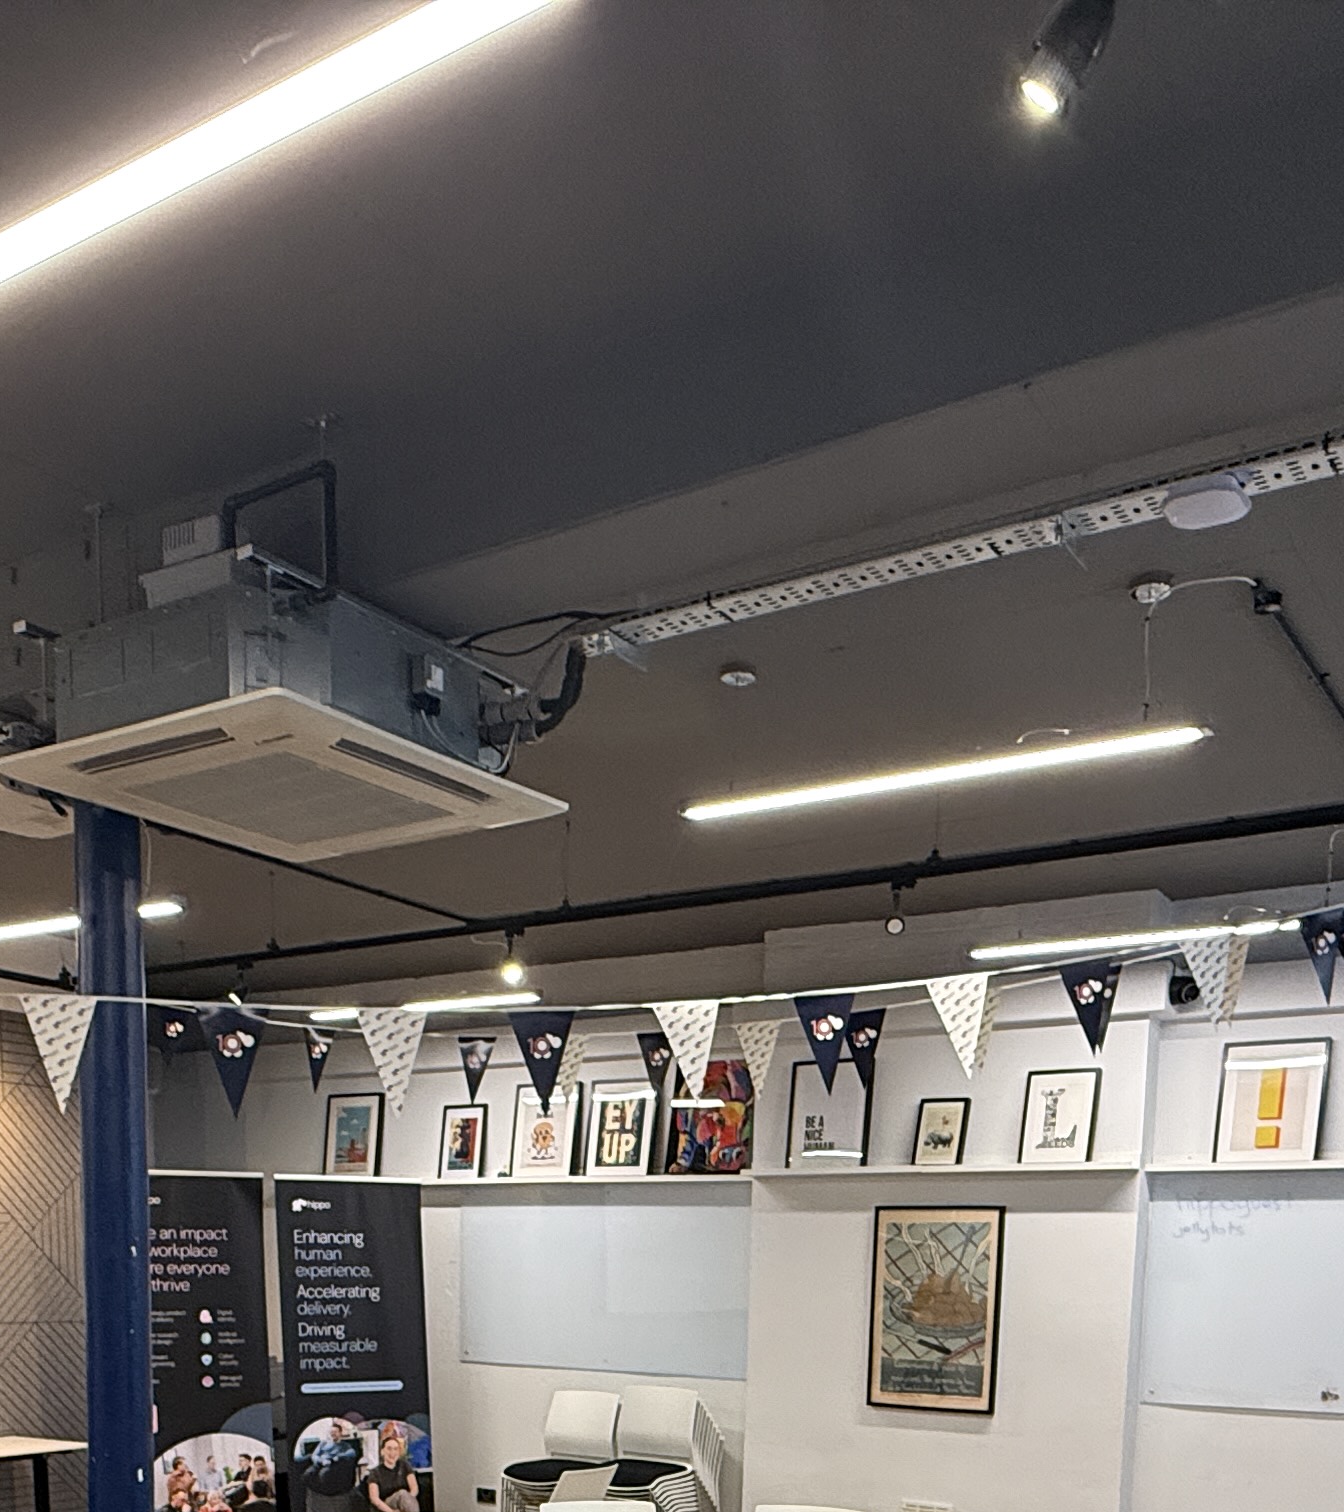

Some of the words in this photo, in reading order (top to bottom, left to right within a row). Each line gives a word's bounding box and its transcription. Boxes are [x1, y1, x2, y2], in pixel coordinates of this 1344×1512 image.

[604, 1100, 639, 1130] EY
[805, 1115, 817, 1128] BE
[818, 1115, 824, 1128] A
[602, 1131, 637, 1163] UP
[306, 1201, 331, 1211] hippo
[159, 1229, 177, 1240] an
[179, 1225, 228, 1244] impact
[293, 1229, 365, 1249] Enhancing
[294, 1246, 343, 1261] human
[166, 1263, 231, 1278] everyone
[295, 1263, 374, 1281] experience.
[150, 1277, 191, 1292] thrive
[296, 1284, 381, 1302] Accelerating
[296, 1300, 353, 1318] delivery.
[297, 1321, 346, 1340] Driving
[298, 1337, 379, 1353] measurable
[299, 1355, 351, 1372] impact.
